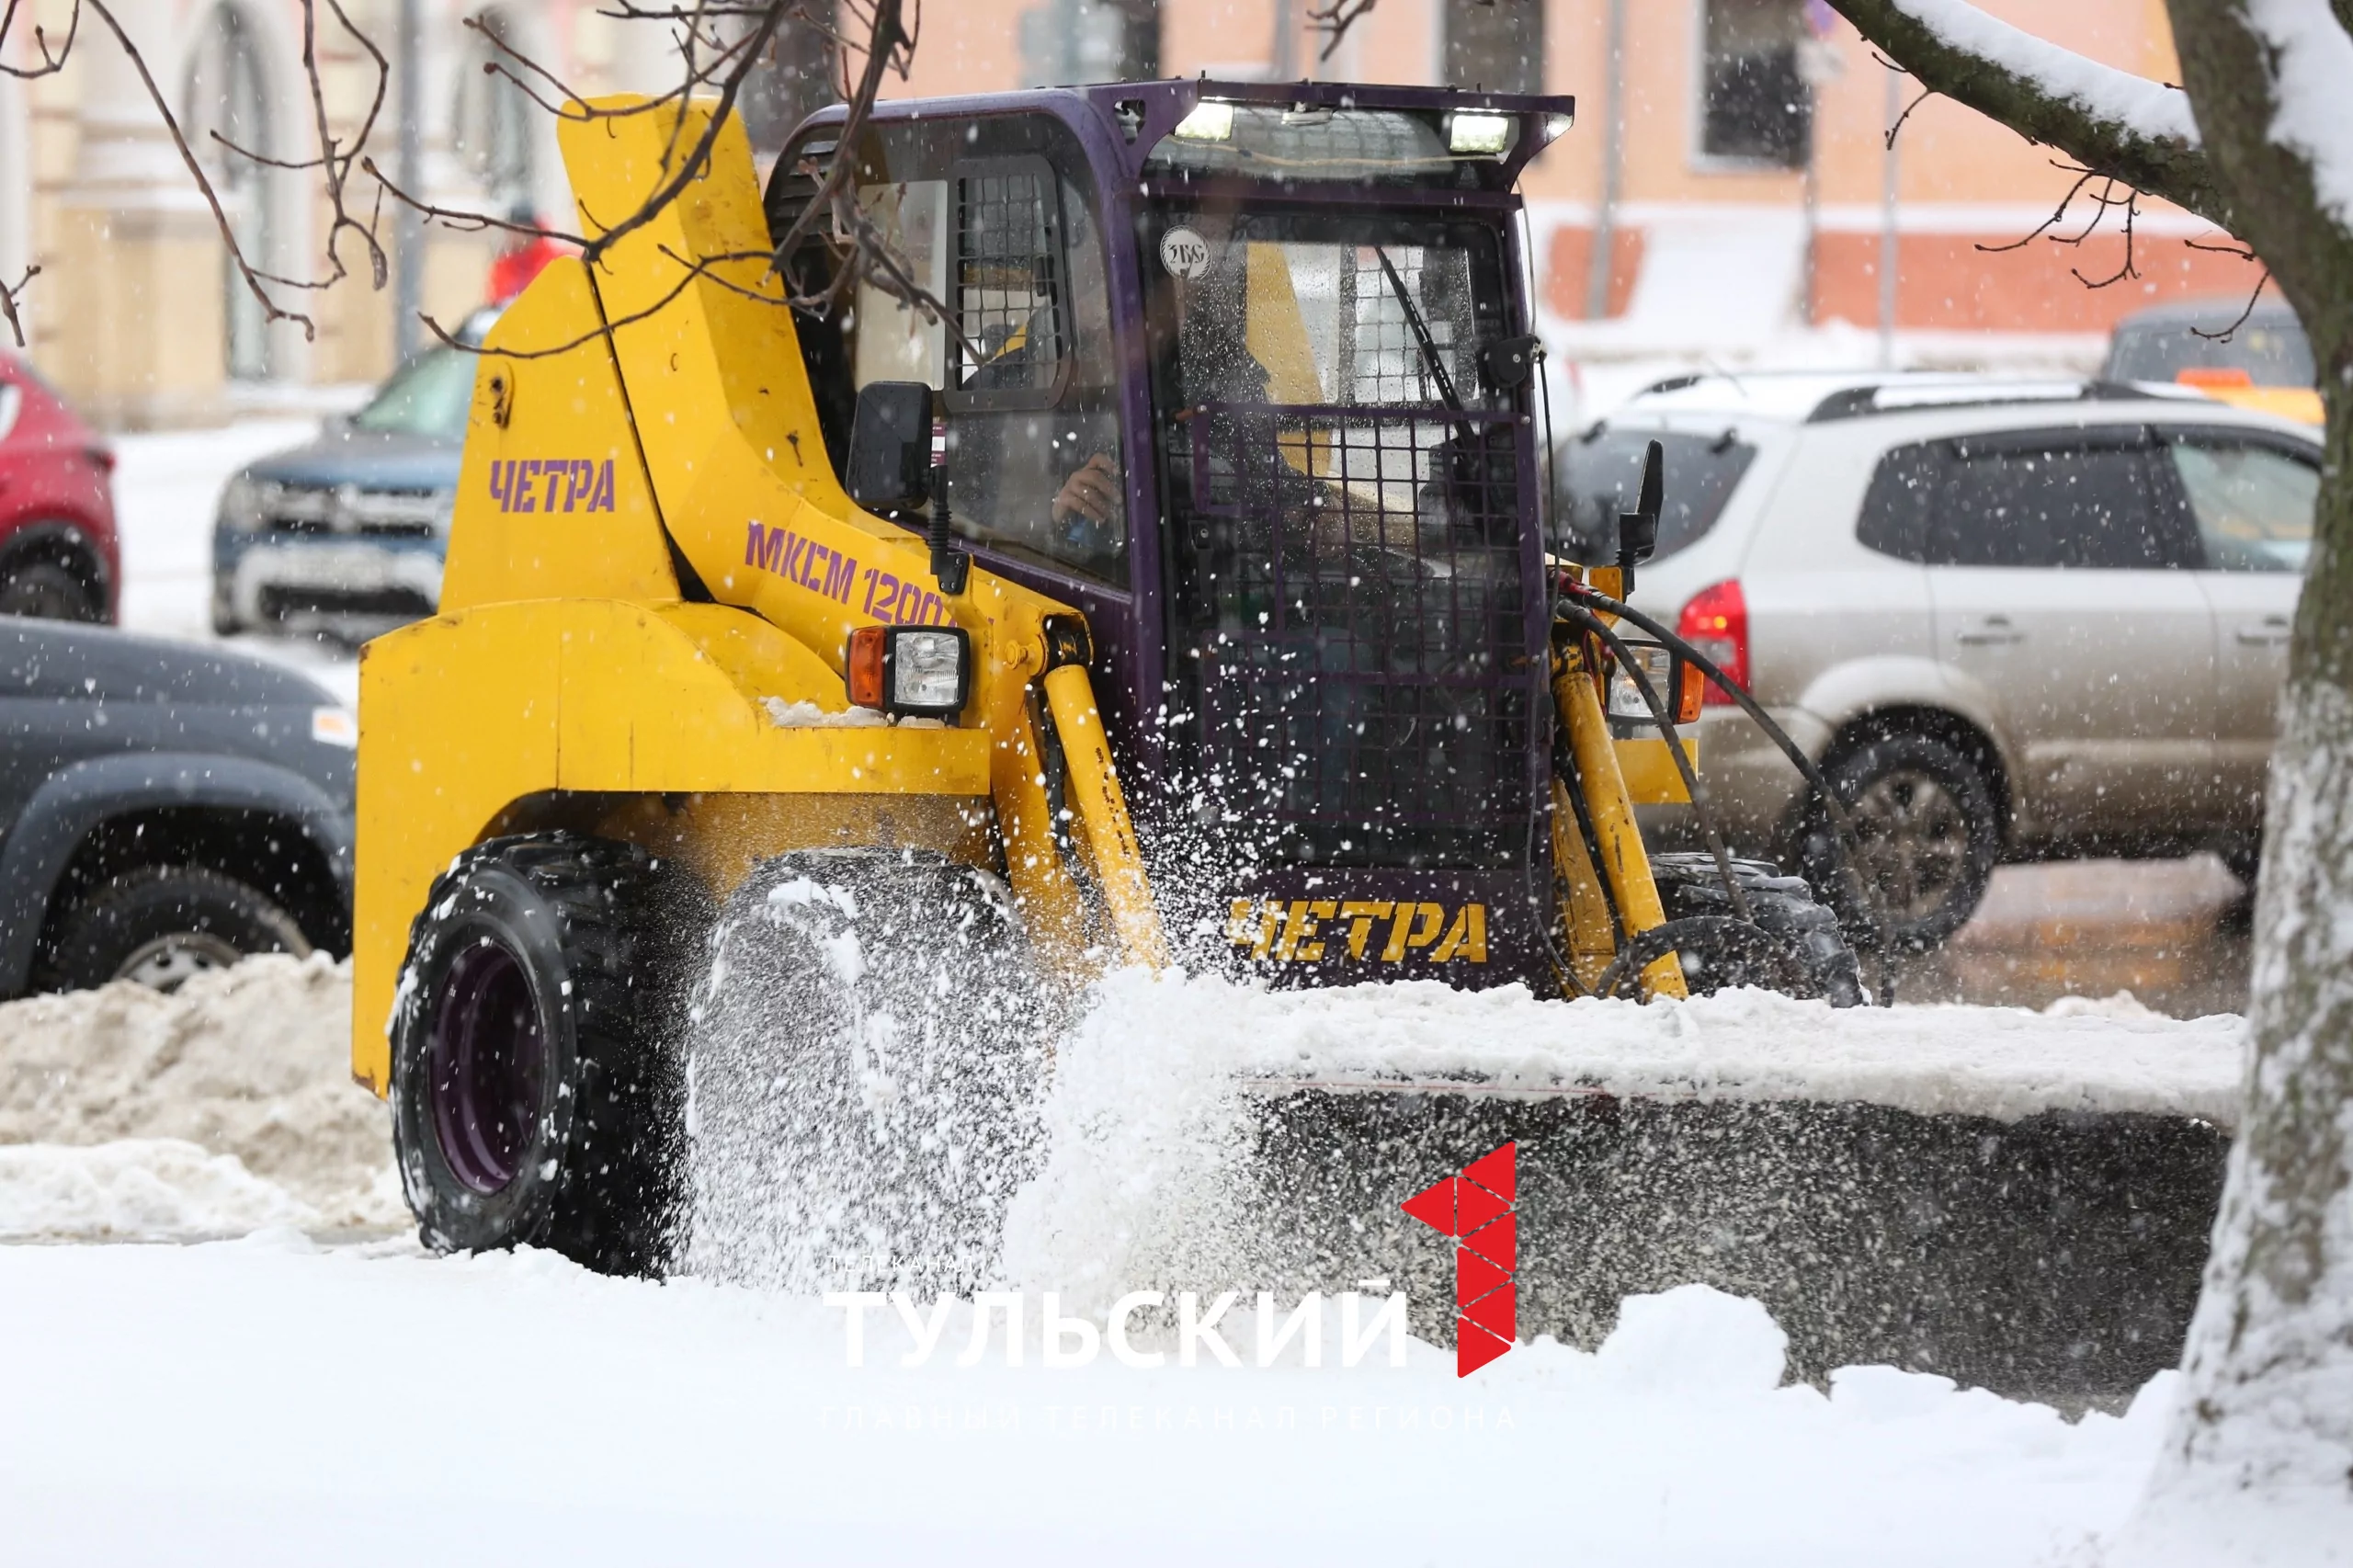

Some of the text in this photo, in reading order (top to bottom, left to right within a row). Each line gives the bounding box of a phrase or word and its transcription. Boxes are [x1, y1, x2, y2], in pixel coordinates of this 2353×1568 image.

[490, 459, 615, 513] ЧЕТРА
[745, 520, 958, 628] МКСМ 1200
[1227, 900, 1487, 962] ЧЕТРА
